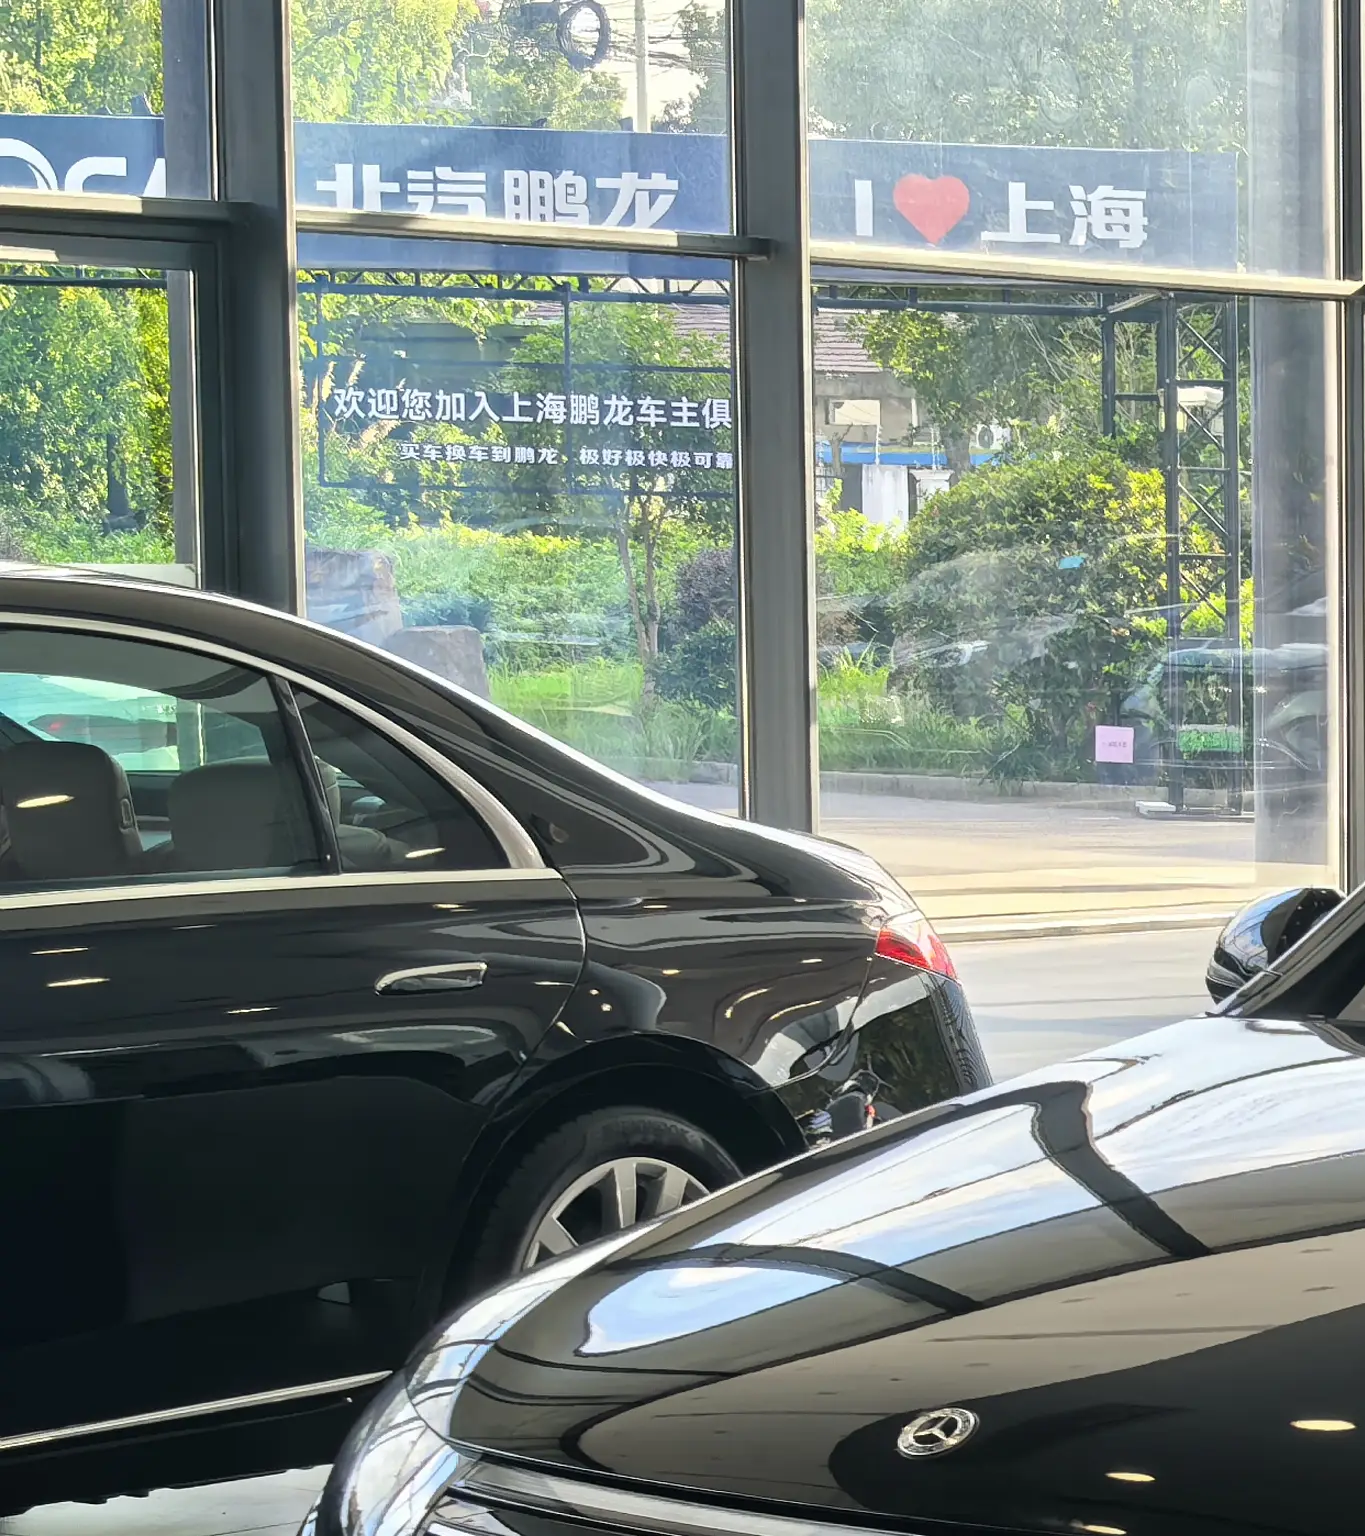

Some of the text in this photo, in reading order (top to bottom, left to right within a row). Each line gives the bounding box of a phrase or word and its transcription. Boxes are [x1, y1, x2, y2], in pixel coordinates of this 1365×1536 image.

[316, 163, 679, 230] 北汽鹏龙
[980, 182, 1149, 249] 上海
[333, 387, 733, 430] 欢迎您加入上海鹏龙车主俱
